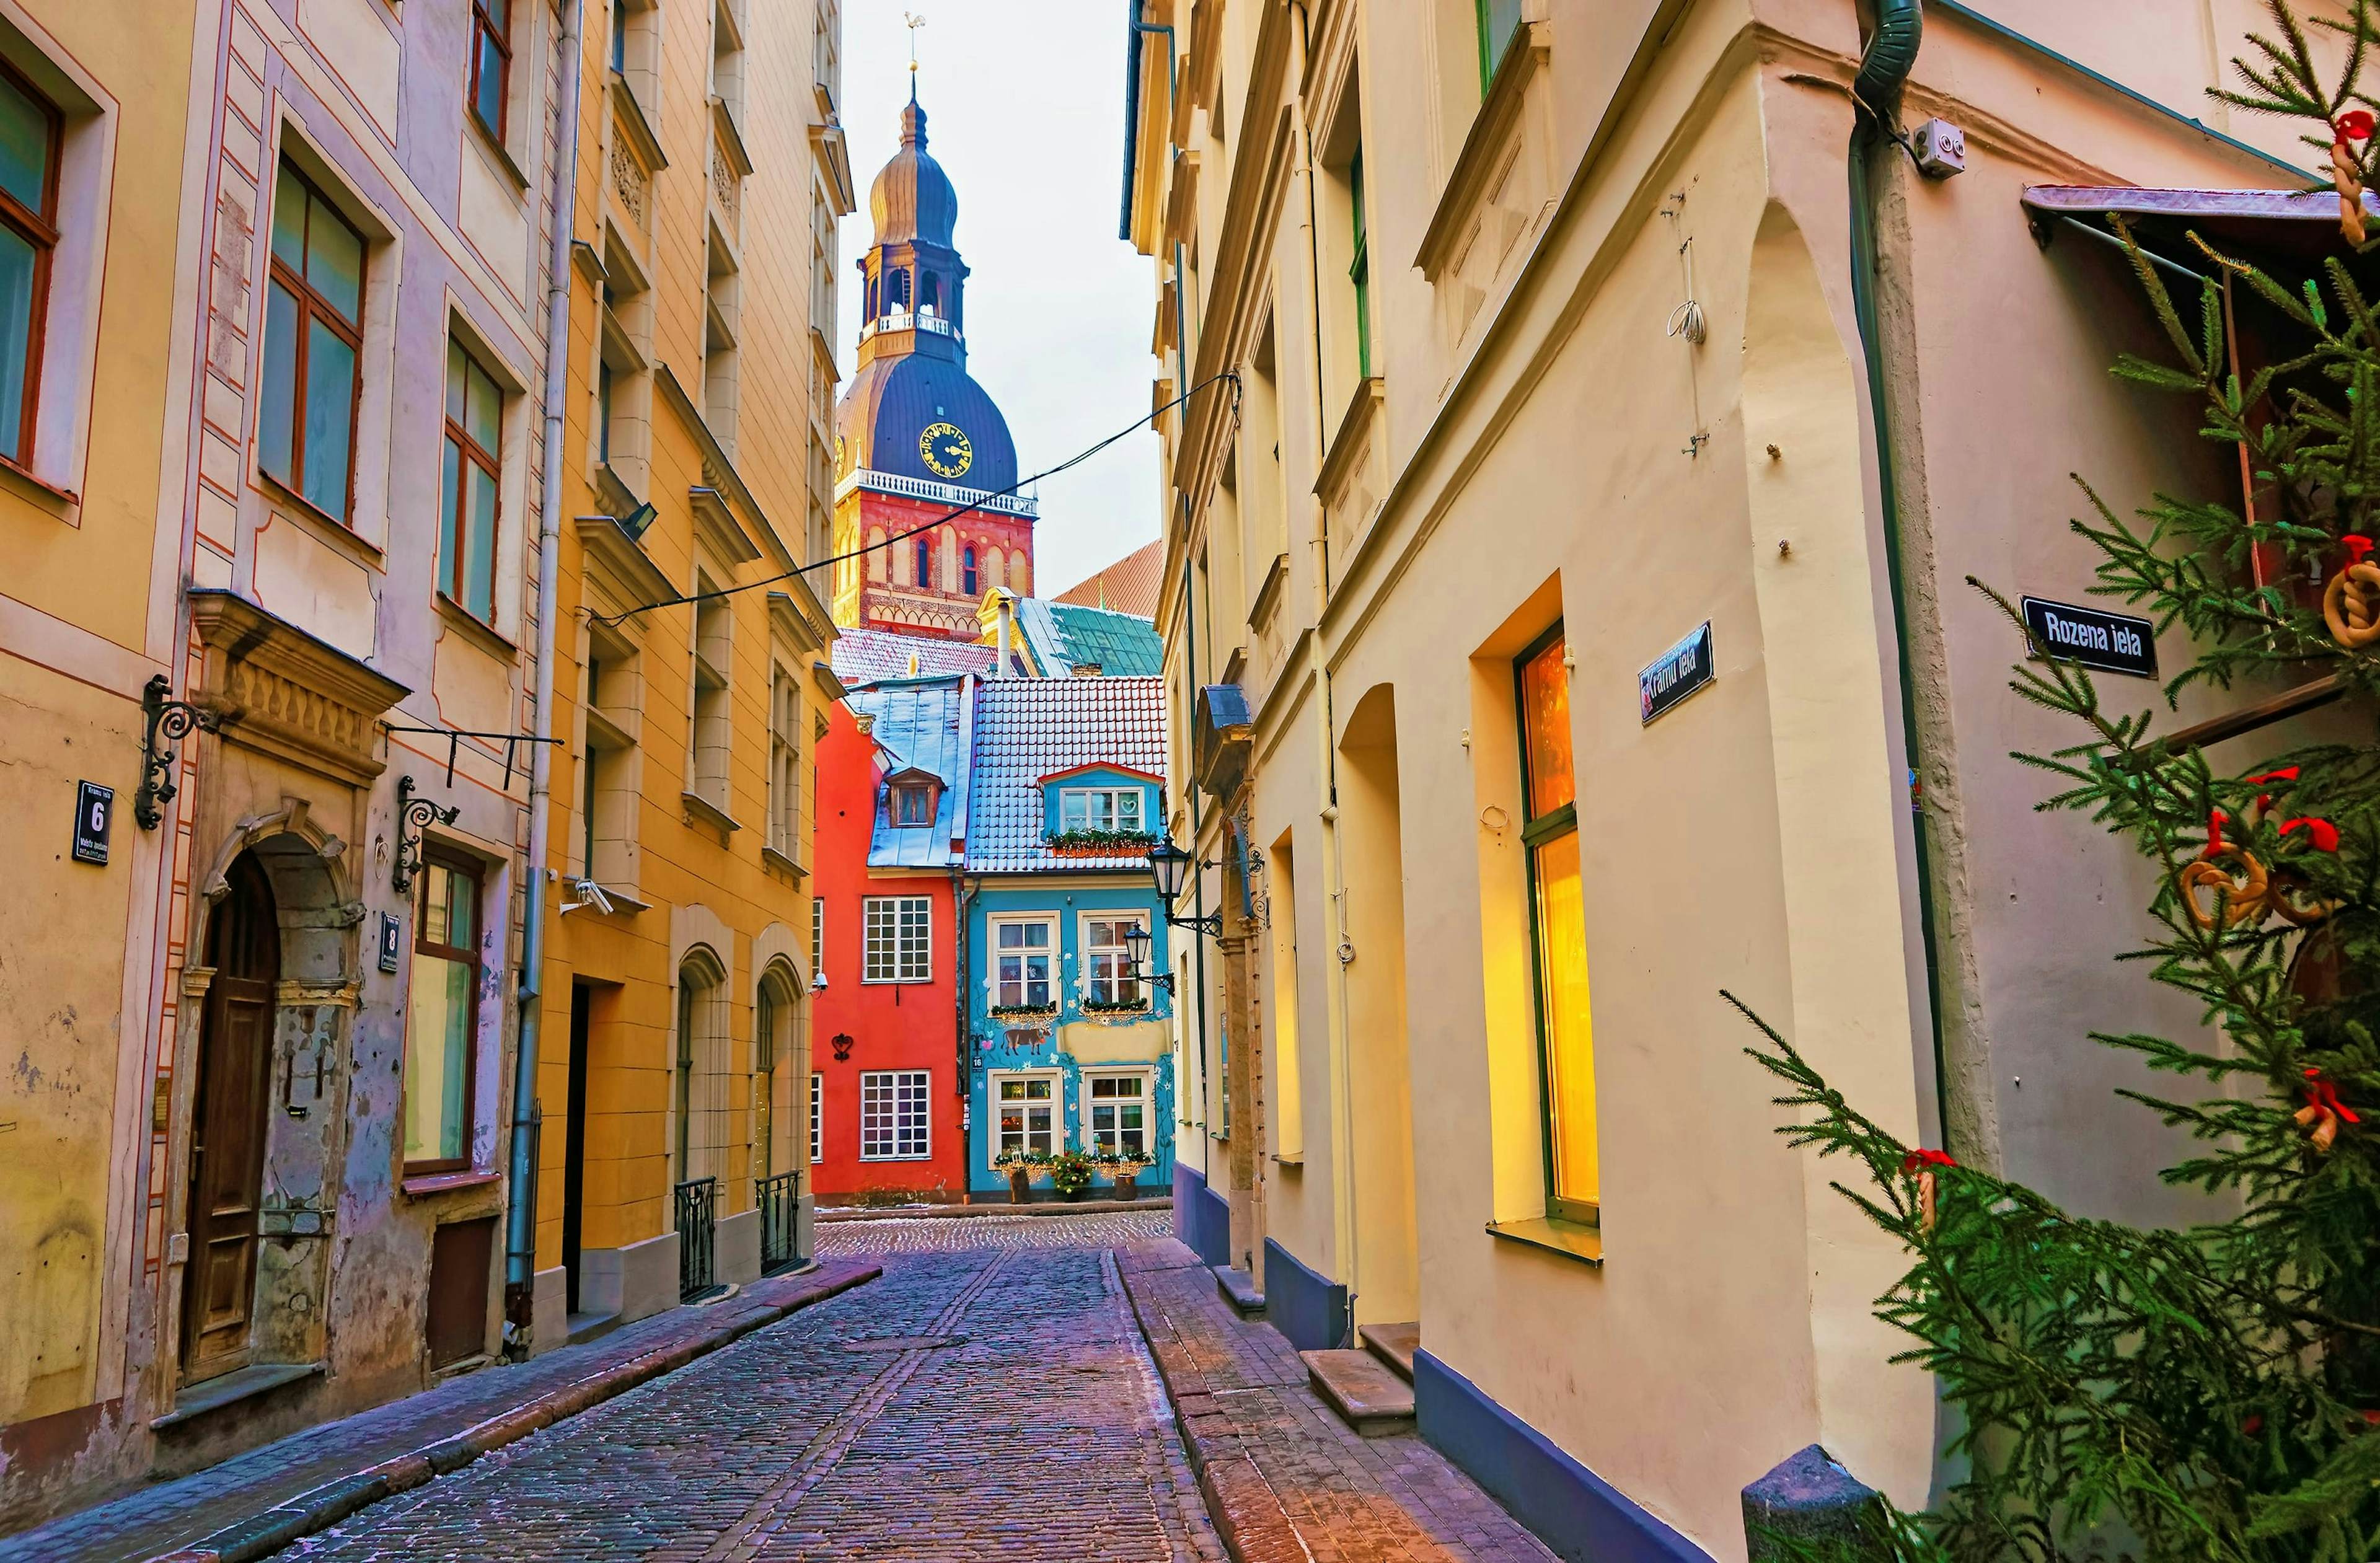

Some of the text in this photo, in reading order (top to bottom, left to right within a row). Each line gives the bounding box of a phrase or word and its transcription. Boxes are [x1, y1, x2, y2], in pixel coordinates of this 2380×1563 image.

[2045, 612, 2142, 657] Rozena iela
[1679, 645, 1696, 679] iela
[91, 802, 105, 832] 6
[389, 929, 396, 951] 8
[973, 1059, 982, 1067] 16
